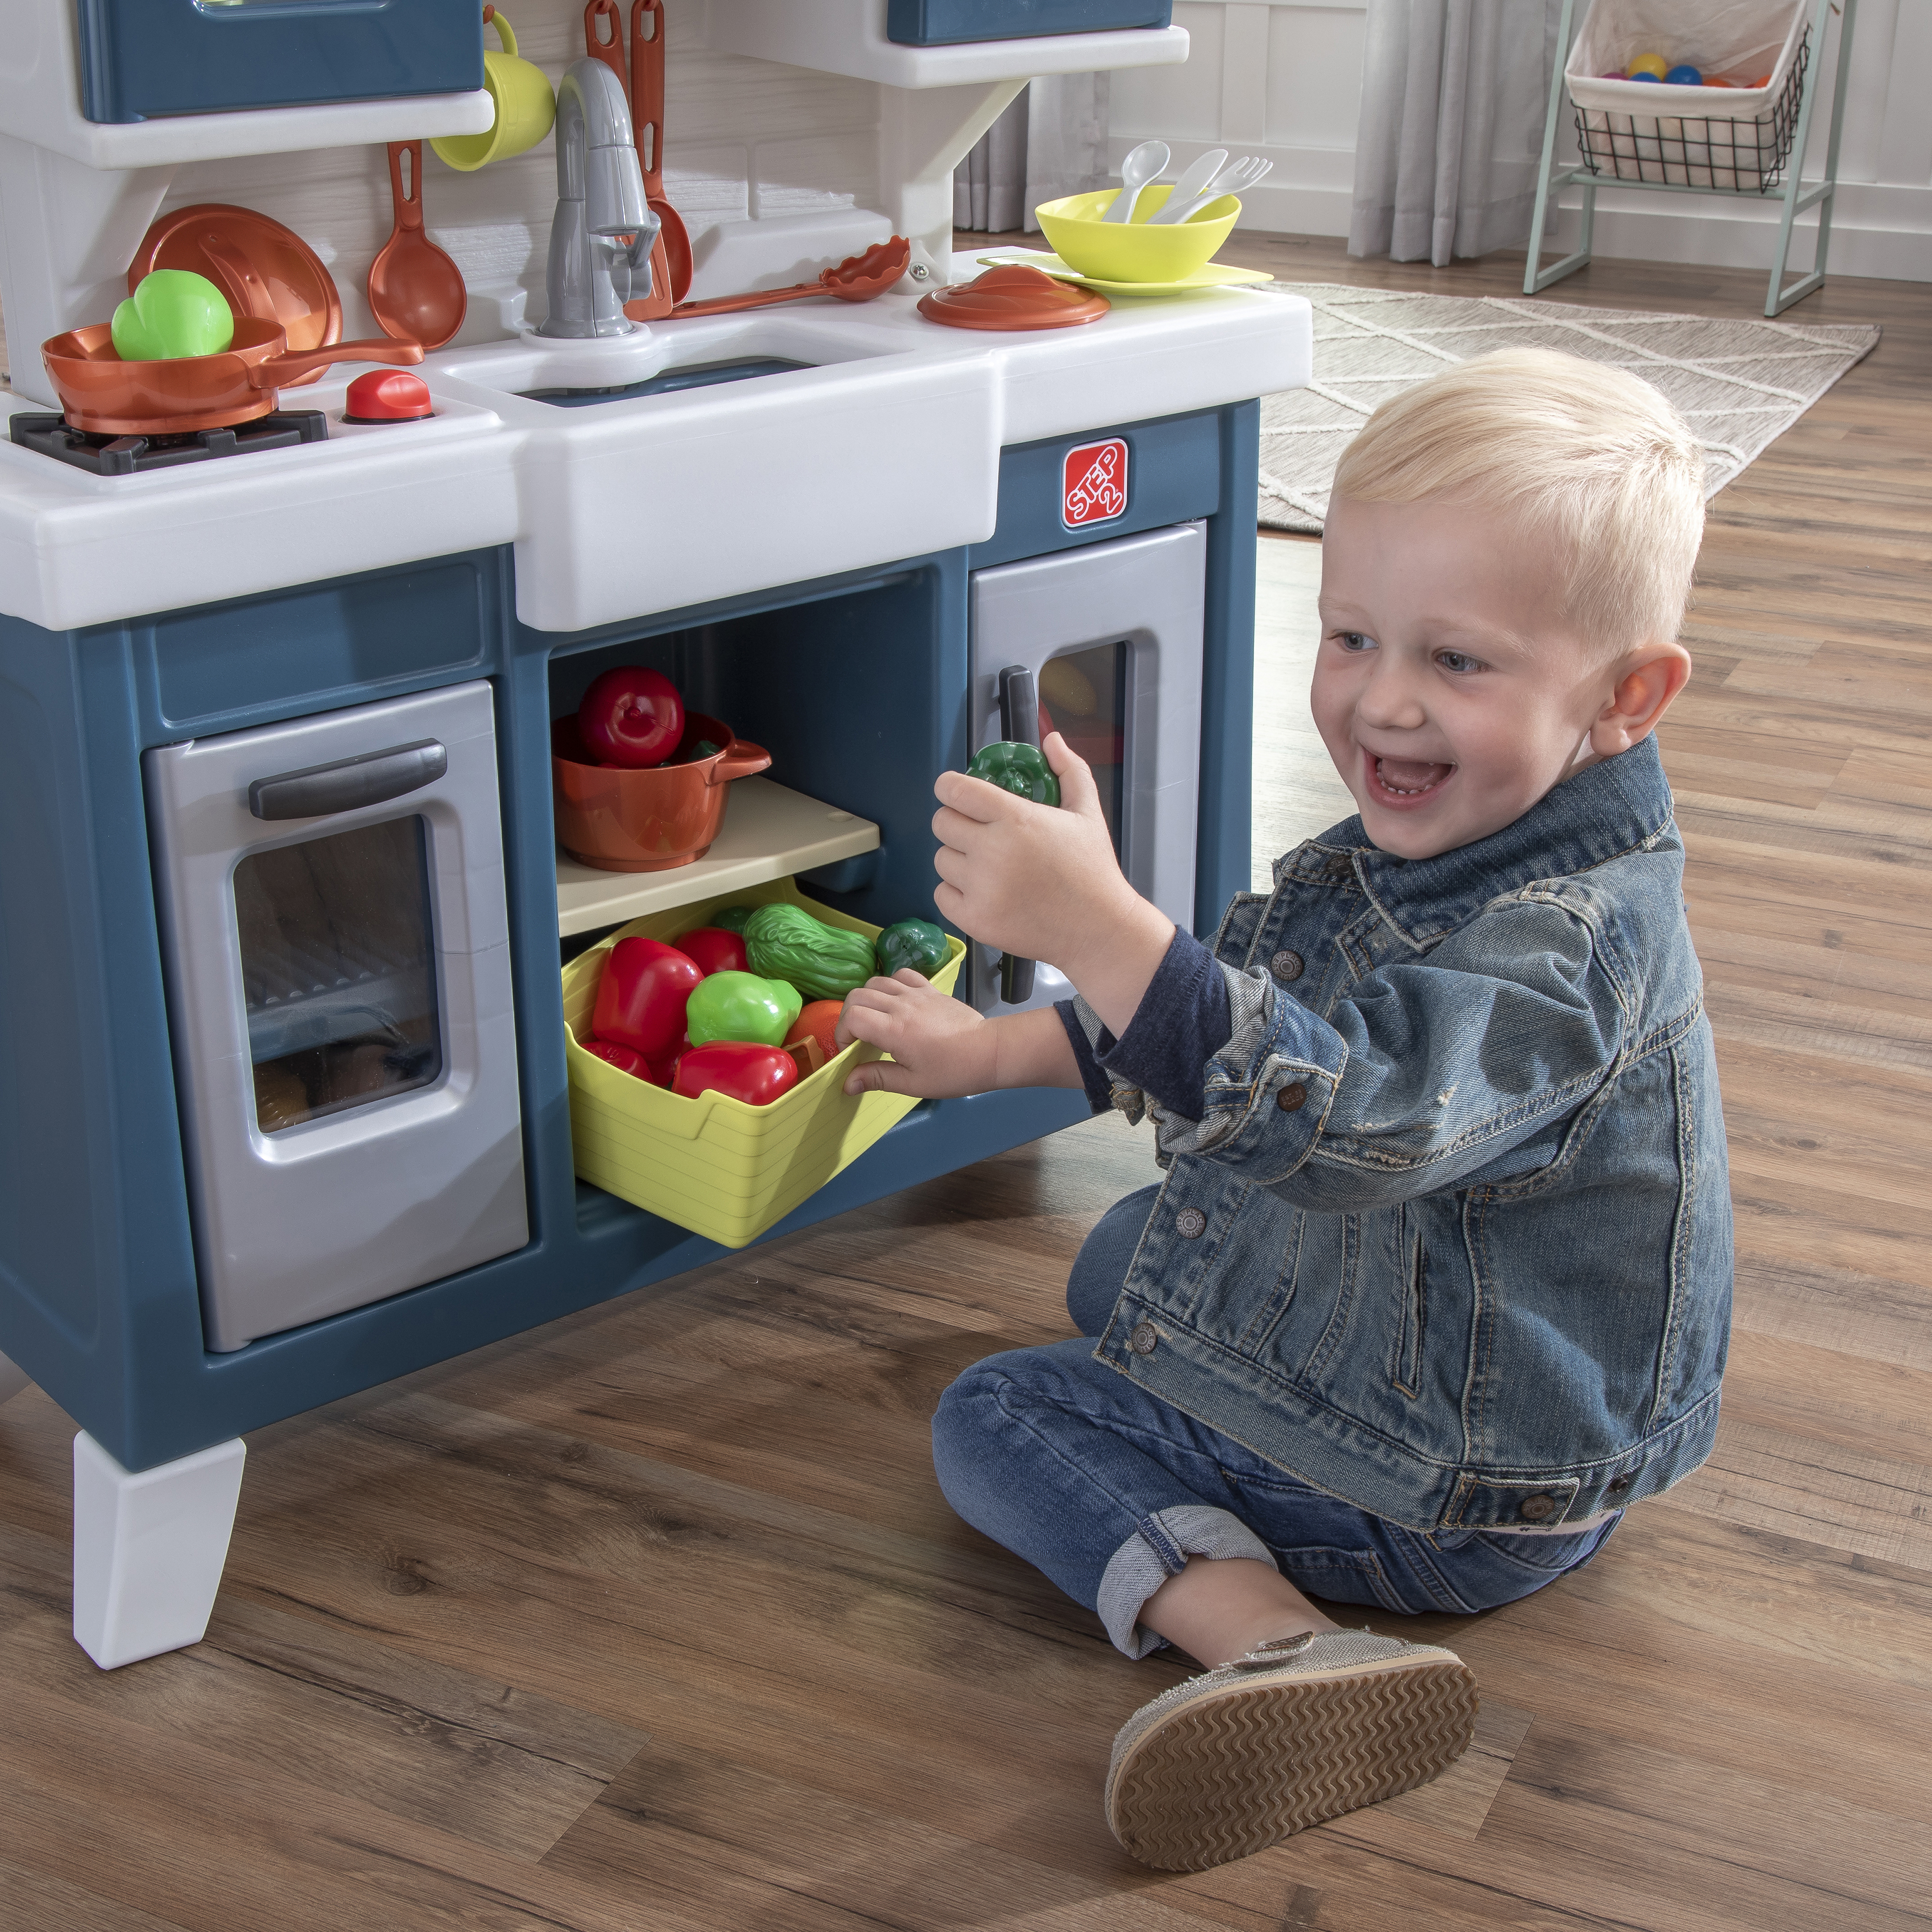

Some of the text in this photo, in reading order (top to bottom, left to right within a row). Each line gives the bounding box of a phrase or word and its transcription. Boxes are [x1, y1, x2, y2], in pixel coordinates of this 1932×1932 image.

[1066, 445, 1118, 520] STEP
[1098, 482, 1123, 514] 2
[1280, 952, 1302, 969] PLACE
[1186, 1209, 1204, 1227] PLACE
[1183, 1229, 1200, 1238] 1989
[1138, 1324, 1155, 1340] PLACE
[1138, 1342, 1153, 1352] 1989
